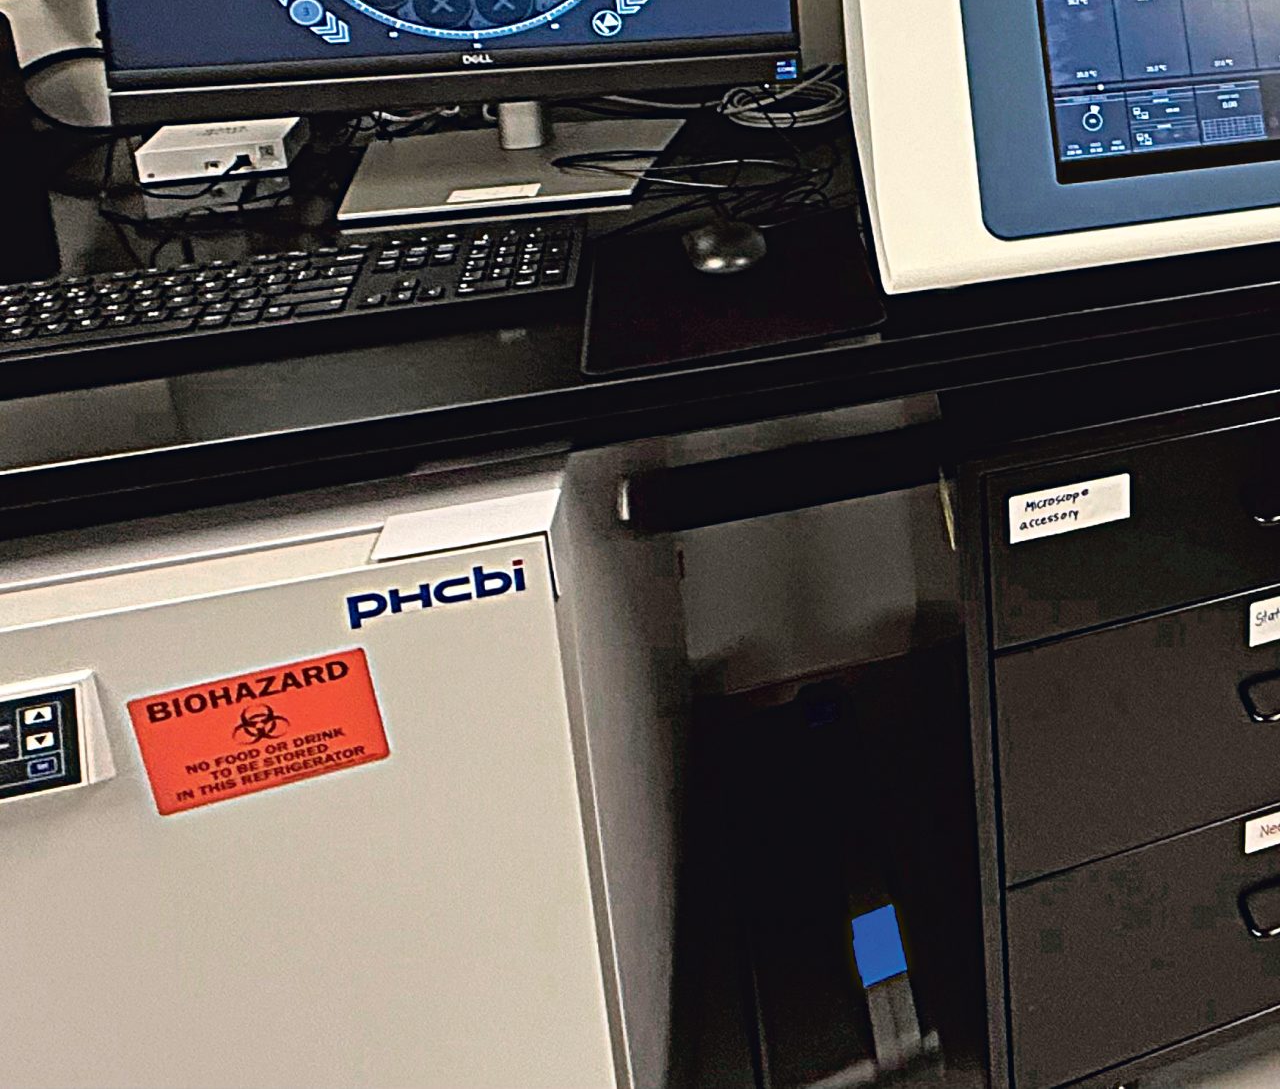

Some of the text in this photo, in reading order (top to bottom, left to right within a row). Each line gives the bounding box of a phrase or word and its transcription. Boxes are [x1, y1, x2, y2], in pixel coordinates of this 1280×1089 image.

[1020, 510, 1079, 530] accessory
[1025, 489, 1089, 512] Microscope
[146, 660, 349, 724] BIOHAZARD
[185, 727, 345, 774] NO FOOD OR DRINK
[210, 743, 330, 781] TO BE STORED
[175, 745, 366, 802] IN THIS REFRIGERATOR
